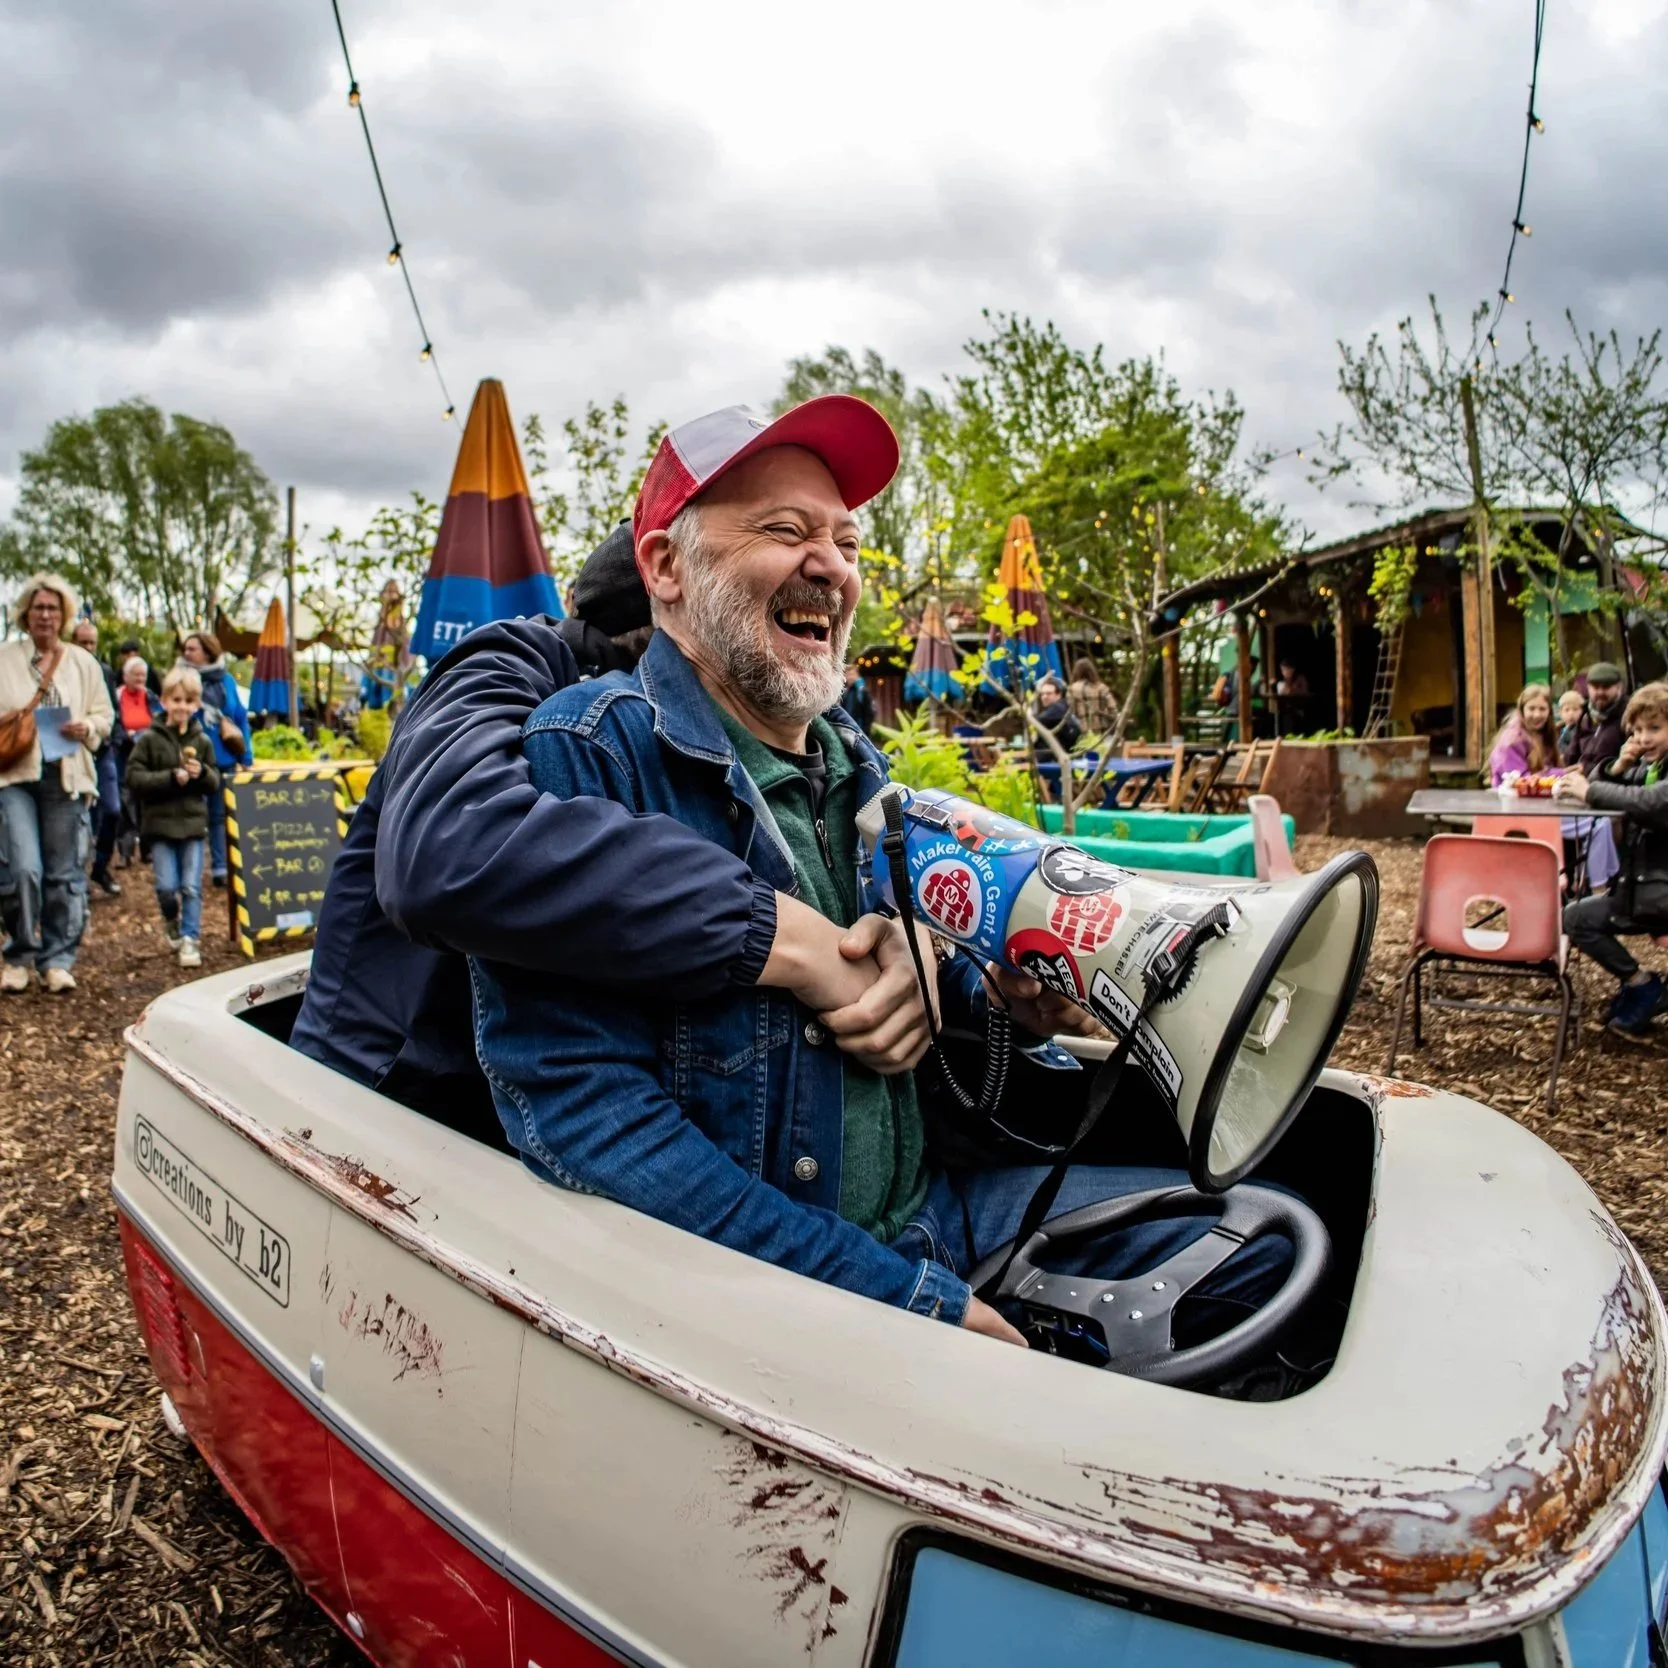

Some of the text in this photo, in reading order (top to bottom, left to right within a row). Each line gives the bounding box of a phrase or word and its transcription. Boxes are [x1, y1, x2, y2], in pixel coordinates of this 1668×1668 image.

[254, 789, 292, 809] BAR
[272, 821, 316, 841] PIZZA
[275, 857, 304, 877] BAR
[911, 841, 962, 870] Maker
[983, 885, 1001, 935] Gent
[944, 886, 958, 904] M
[1037, 957, 1066, 994] 45
[1058, 959, 1078, 1000] TECH
[1098, 1009, 1128, 1037] sugges
[1101, 983, 1175, 1082] Don't omplain
[153, 1147, 281, 1289] creations_by_b2
